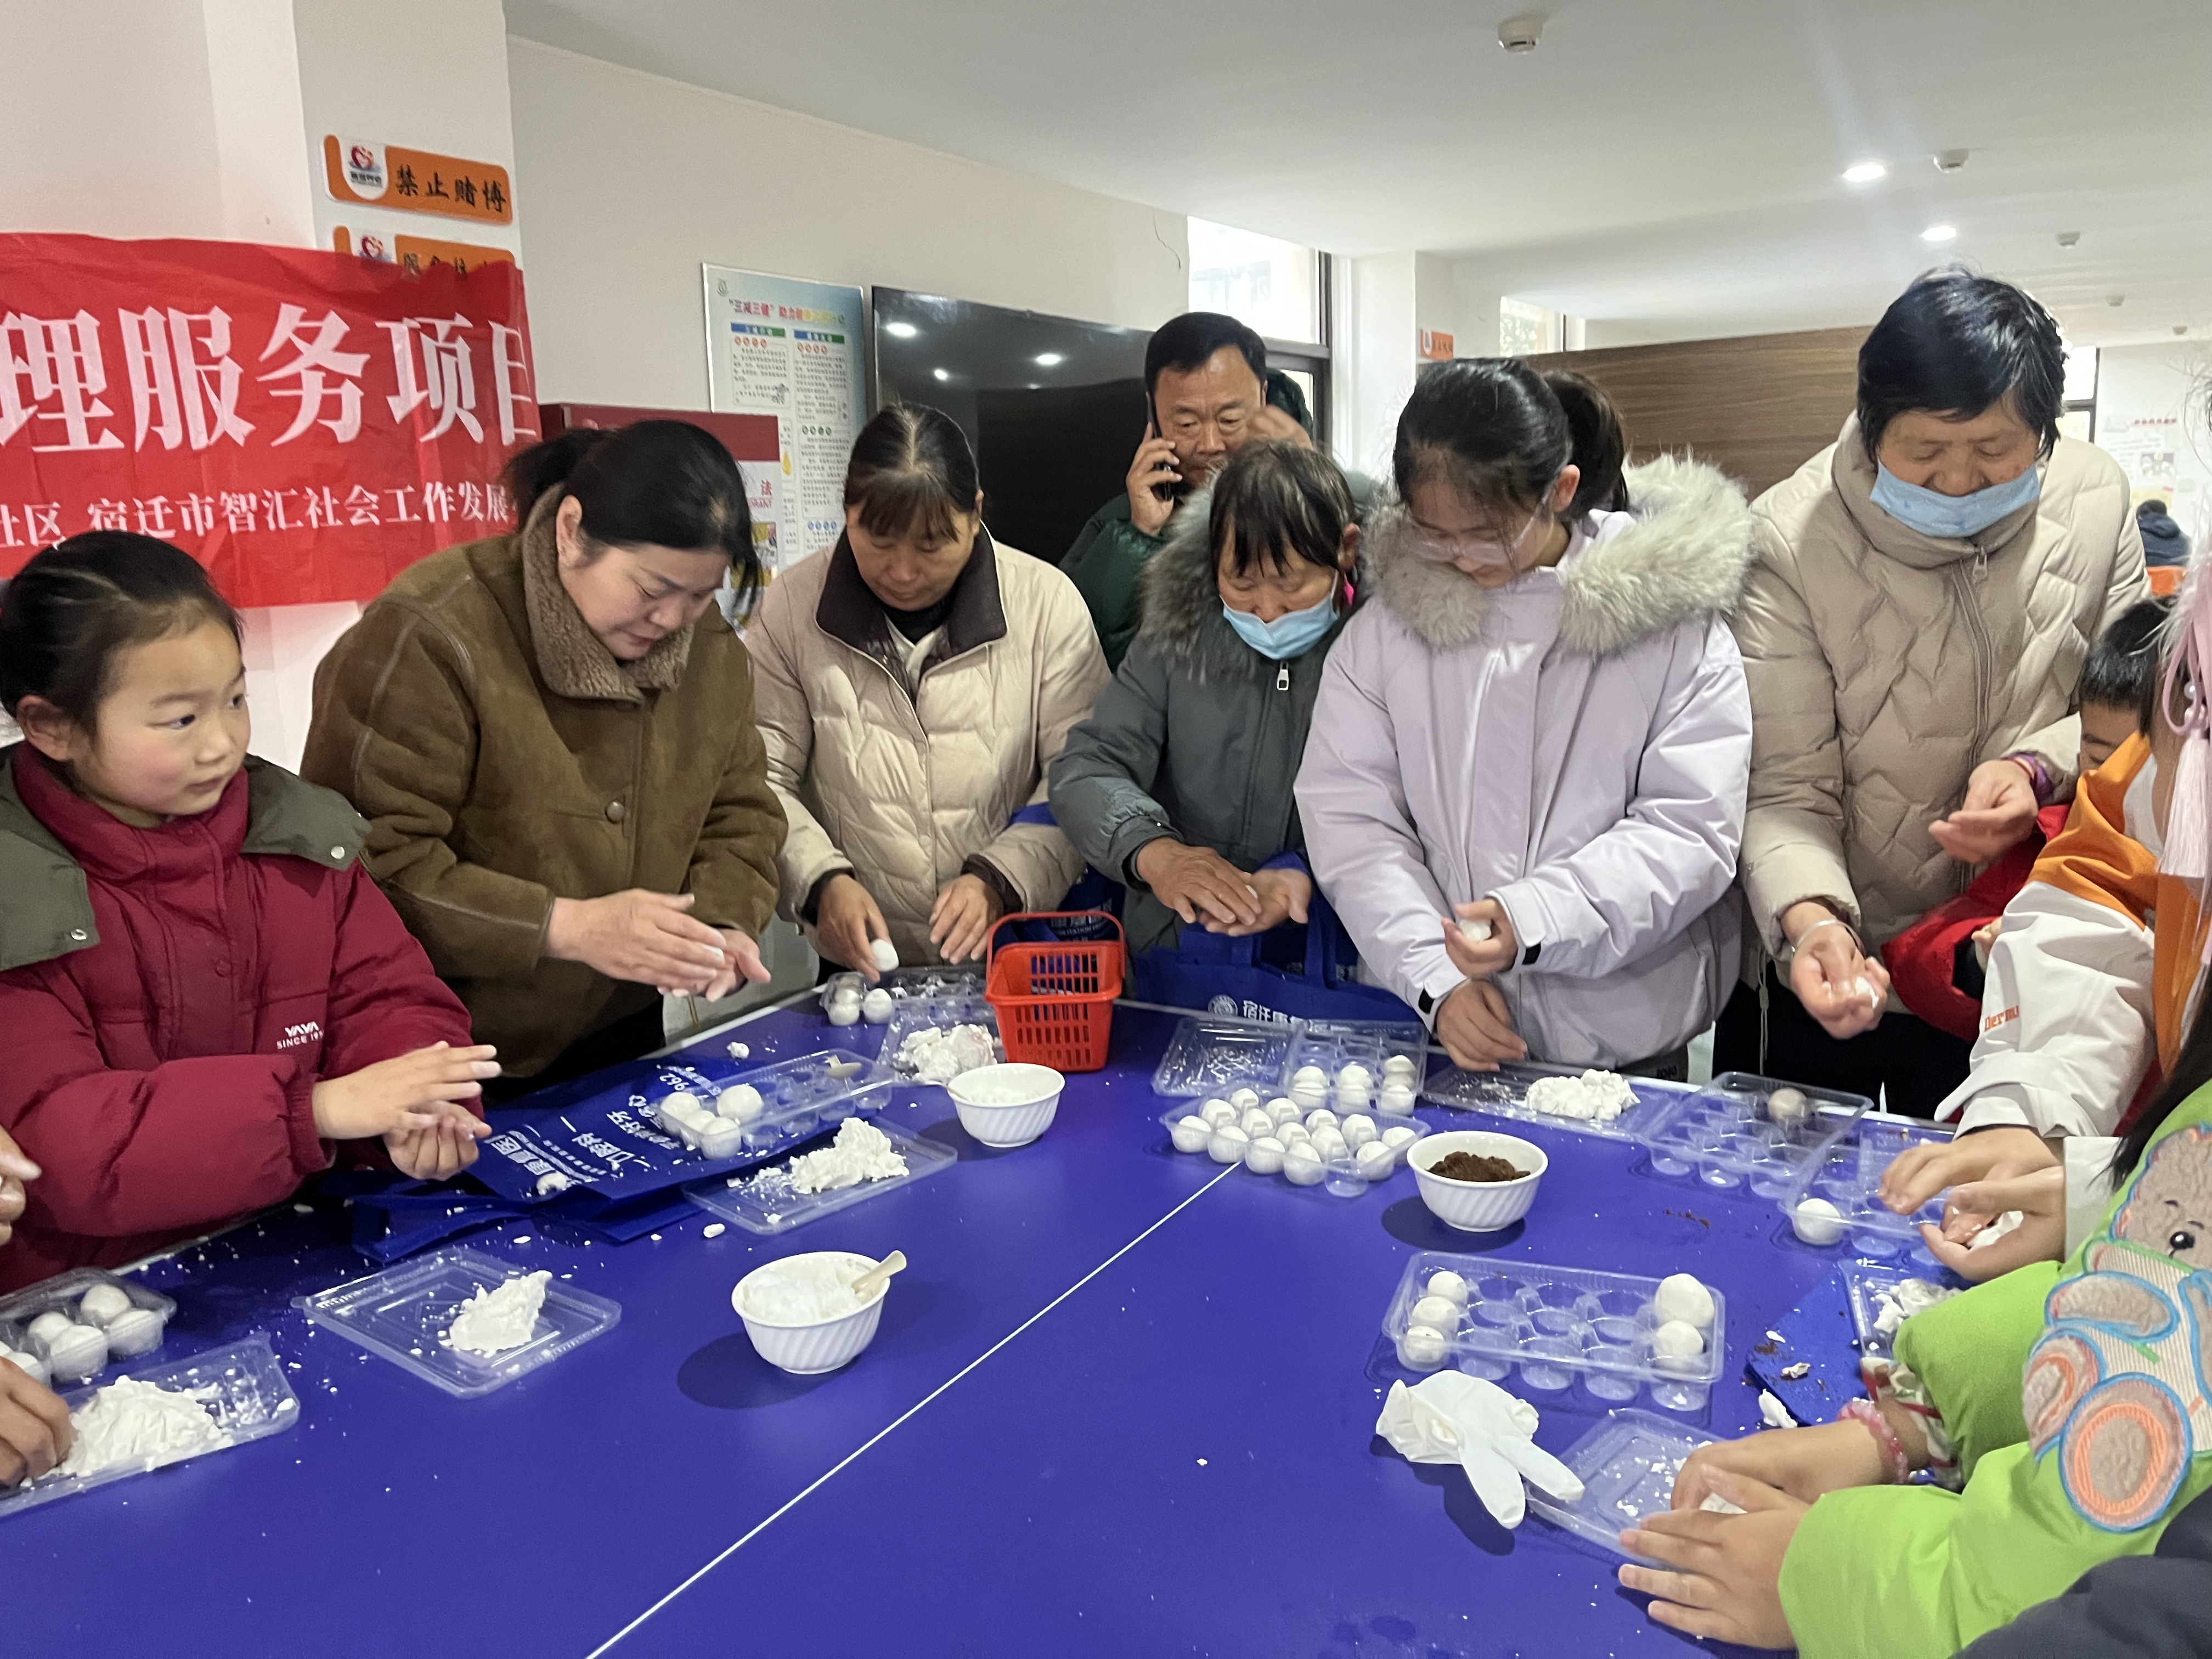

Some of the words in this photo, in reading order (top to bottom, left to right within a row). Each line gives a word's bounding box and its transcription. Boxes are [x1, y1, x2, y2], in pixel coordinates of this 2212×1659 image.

[396, 164, 506, 213] 禁止赌博
[0, 303, 536, 452] 理服务项目
[87, 481, 517, 538] 宿迁市智汇社会工作发展
